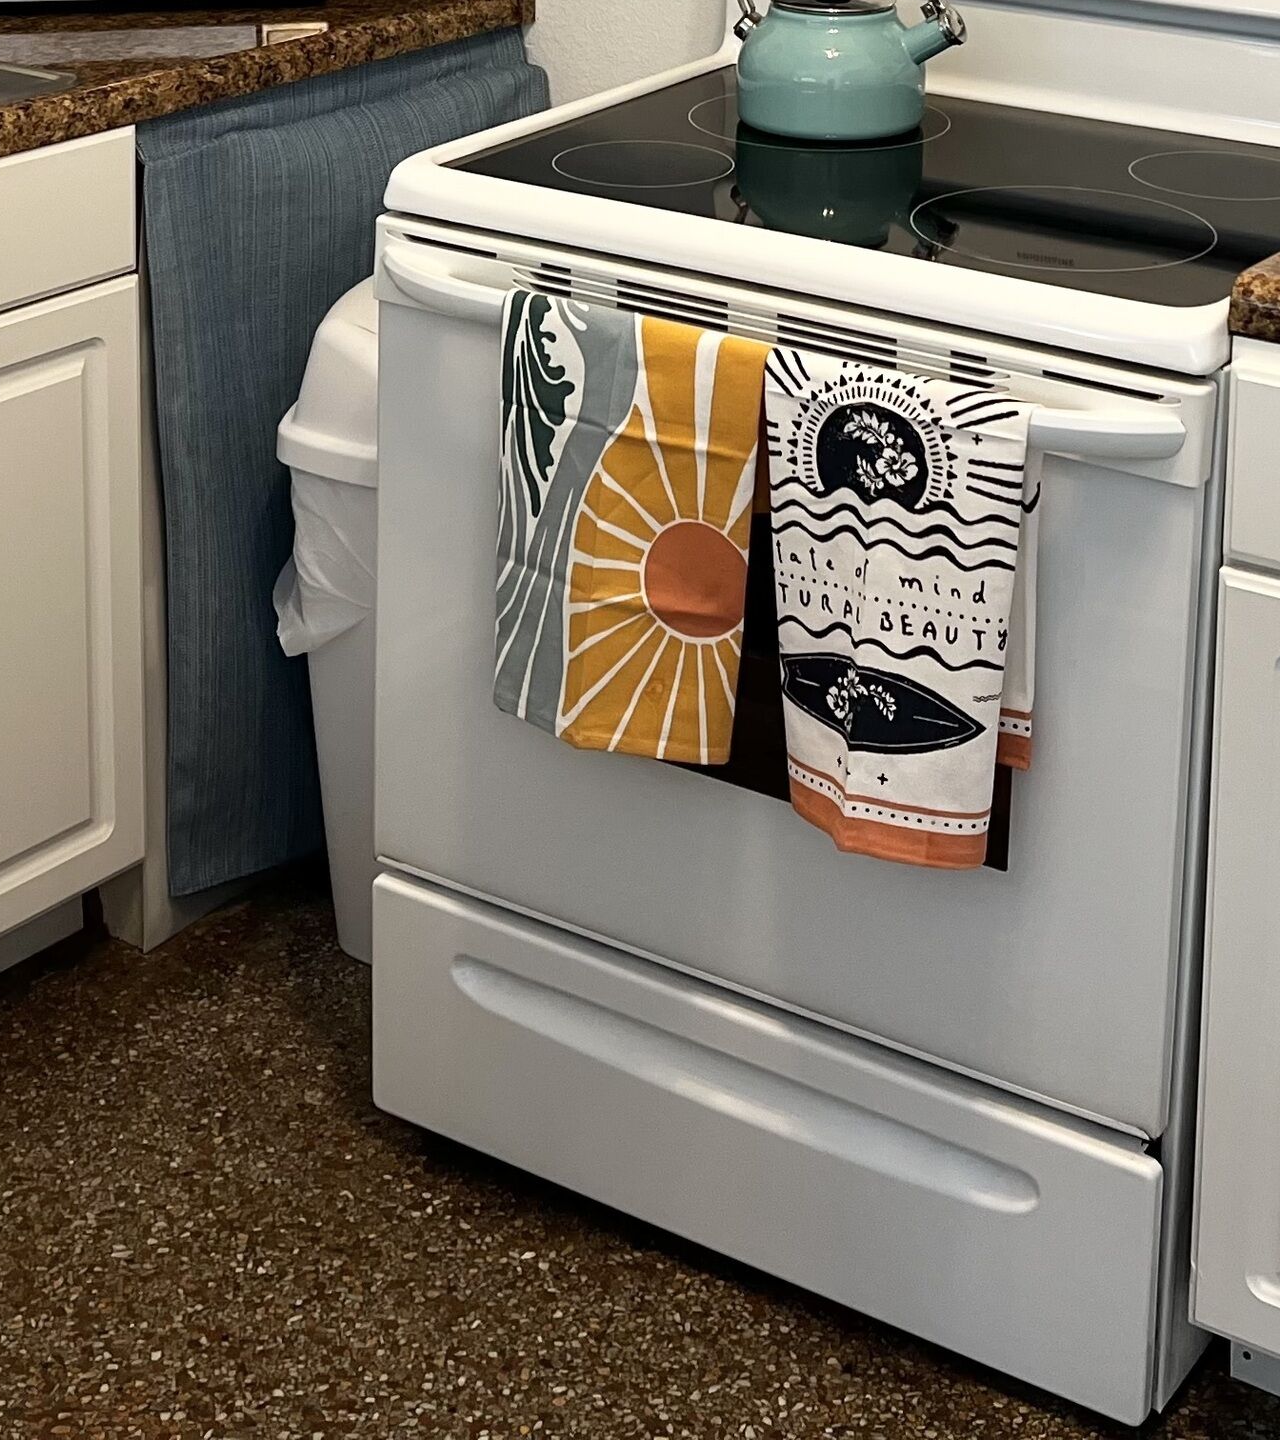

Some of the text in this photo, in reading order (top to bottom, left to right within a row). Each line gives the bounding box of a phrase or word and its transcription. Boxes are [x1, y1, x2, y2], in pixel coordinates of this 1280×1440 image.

[775, 539, 835, 571] tate
[898, 574, 987, 605] mind
[777, 581, 861, 625] TURAL
